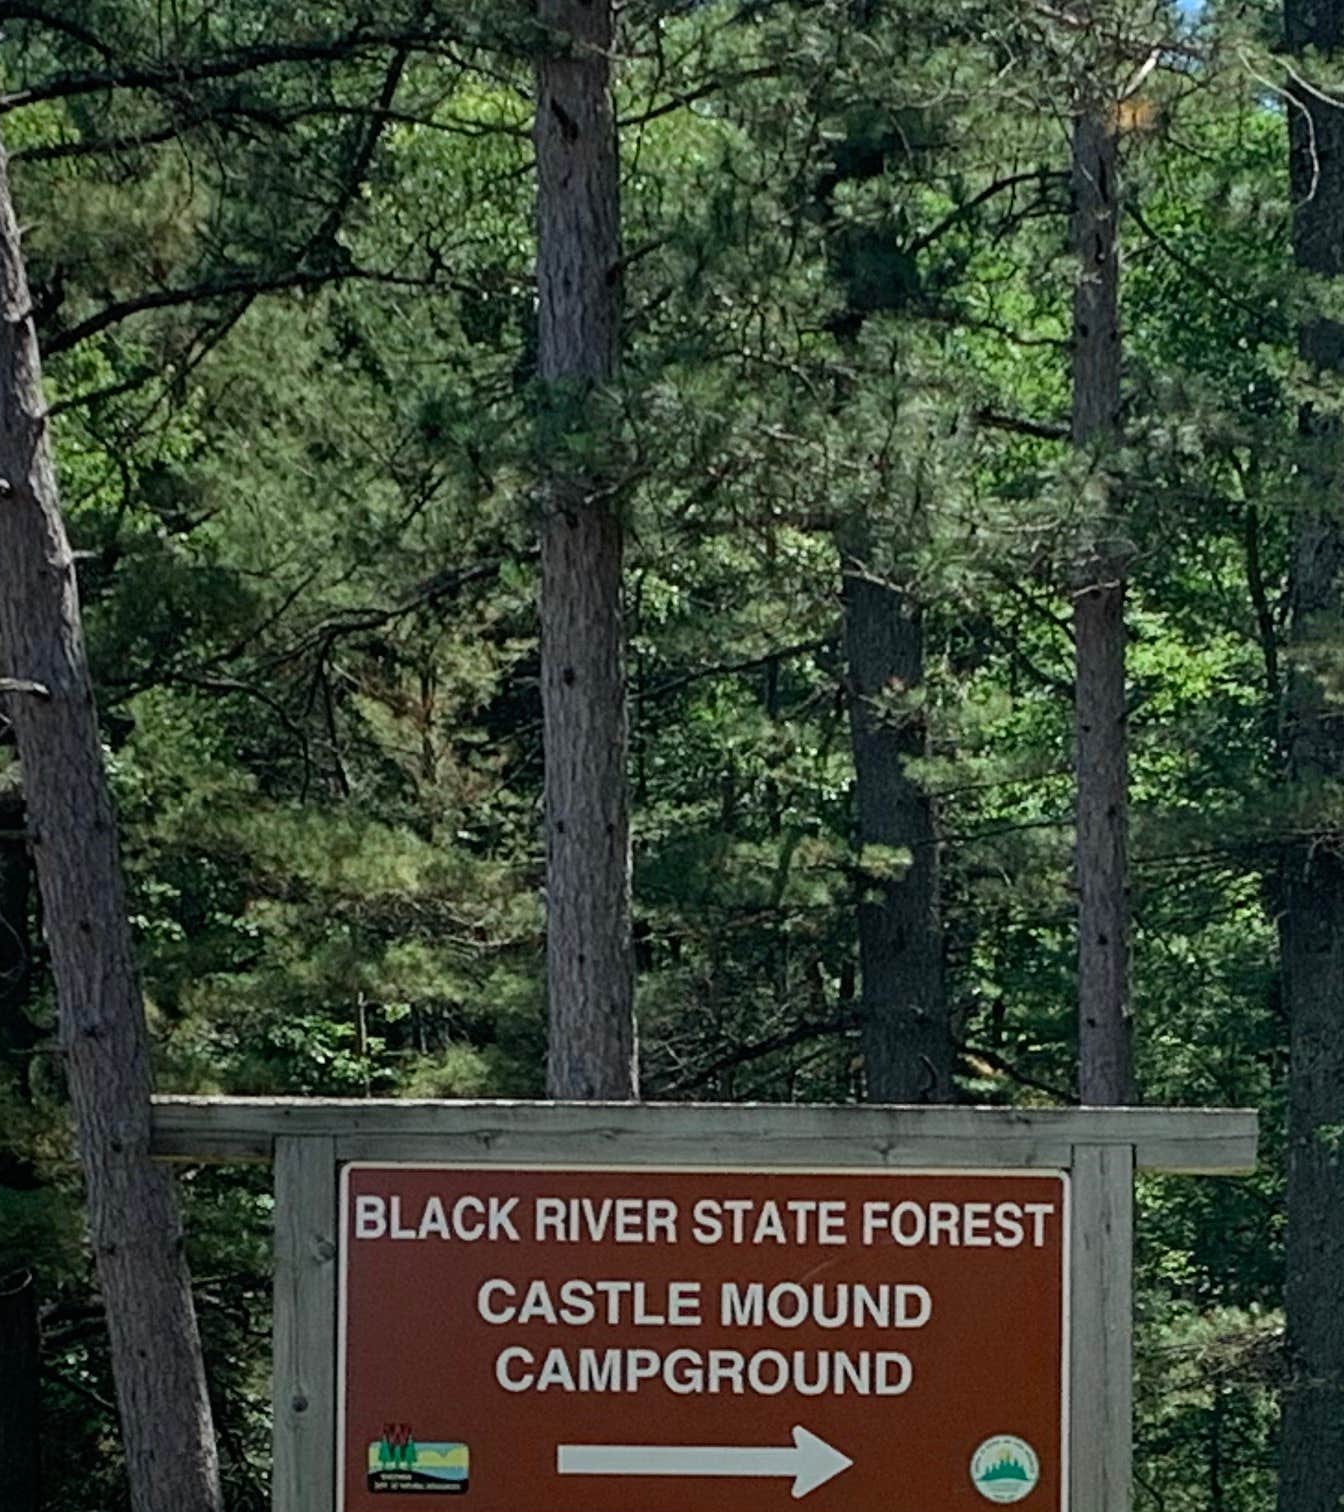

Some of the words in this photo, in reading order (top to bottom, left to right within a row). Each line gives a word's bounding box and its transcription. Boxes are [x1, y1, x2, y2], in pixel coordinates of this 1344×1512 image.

[355, 1195, 520, 1241] BLACK
[536, 1198, 678, 1243] RIVER
[692, 1199, 847, 1245] STATE
[863, 1201, 1055, 1247] FOREST
[477, 1279, 702, 1326] CASTLE
[721, 1282, 933, 1328] MOUND
[495, 1346, 913, 1395] CAMPGROUND
